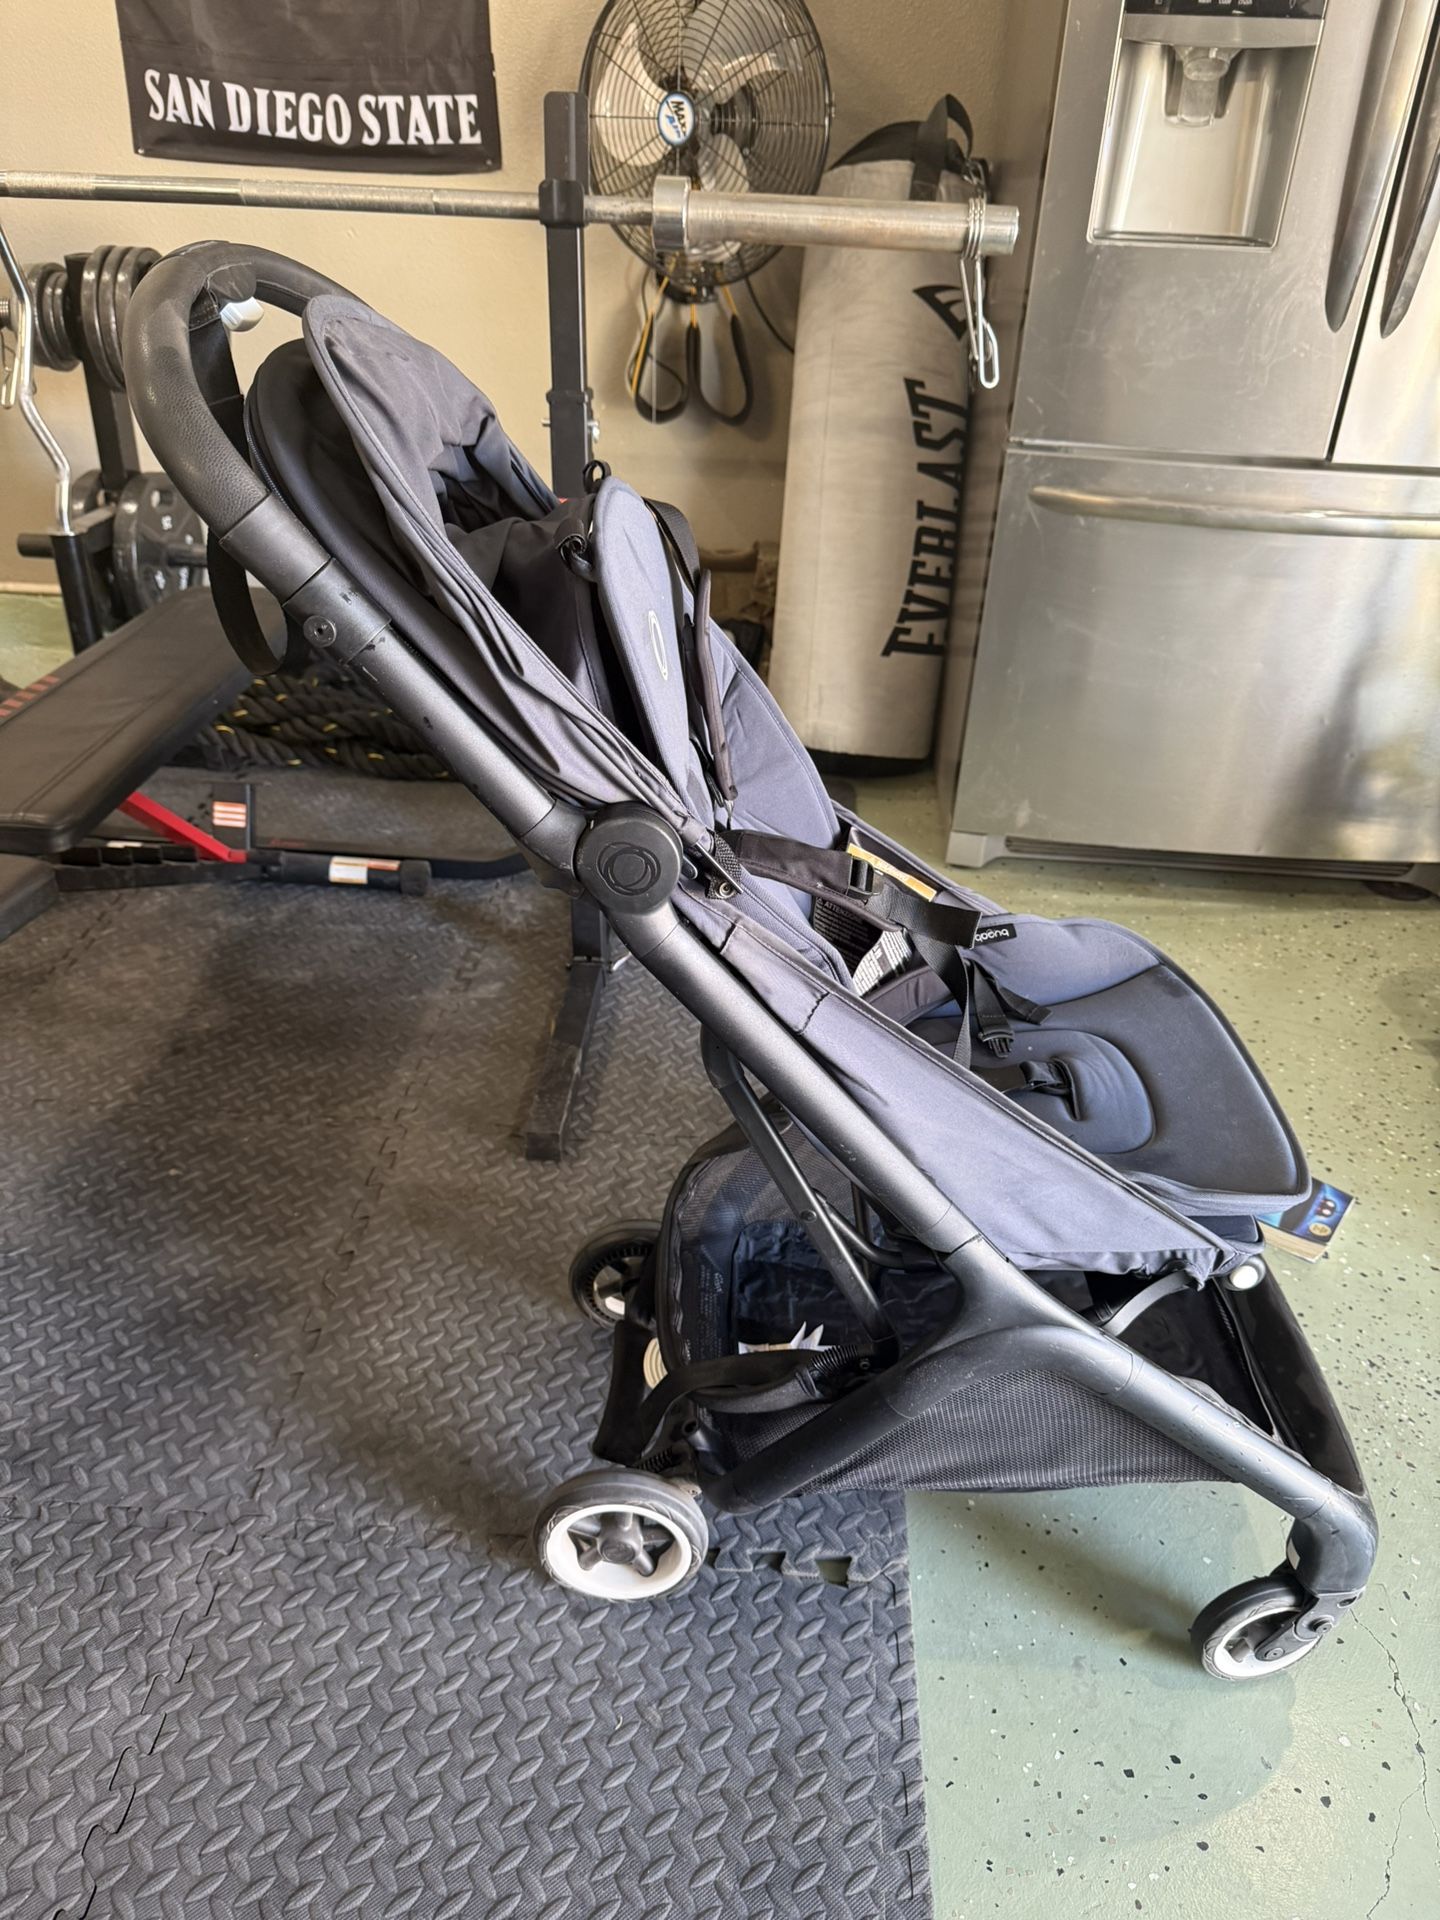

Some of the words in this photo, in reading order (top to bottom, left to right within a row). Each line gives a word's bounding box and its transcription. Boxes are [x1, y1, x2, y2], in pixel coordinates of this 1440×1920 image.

[144, 69, 216, 131] SAN
[222, 82, 352, 146] DIEGO
[358, 94, 482, 146] STATE
[670, 101, 687, 137] MAX
[880, 377, 971, 658] EVERLAST
[974, 928, 1010, 942] bugab
